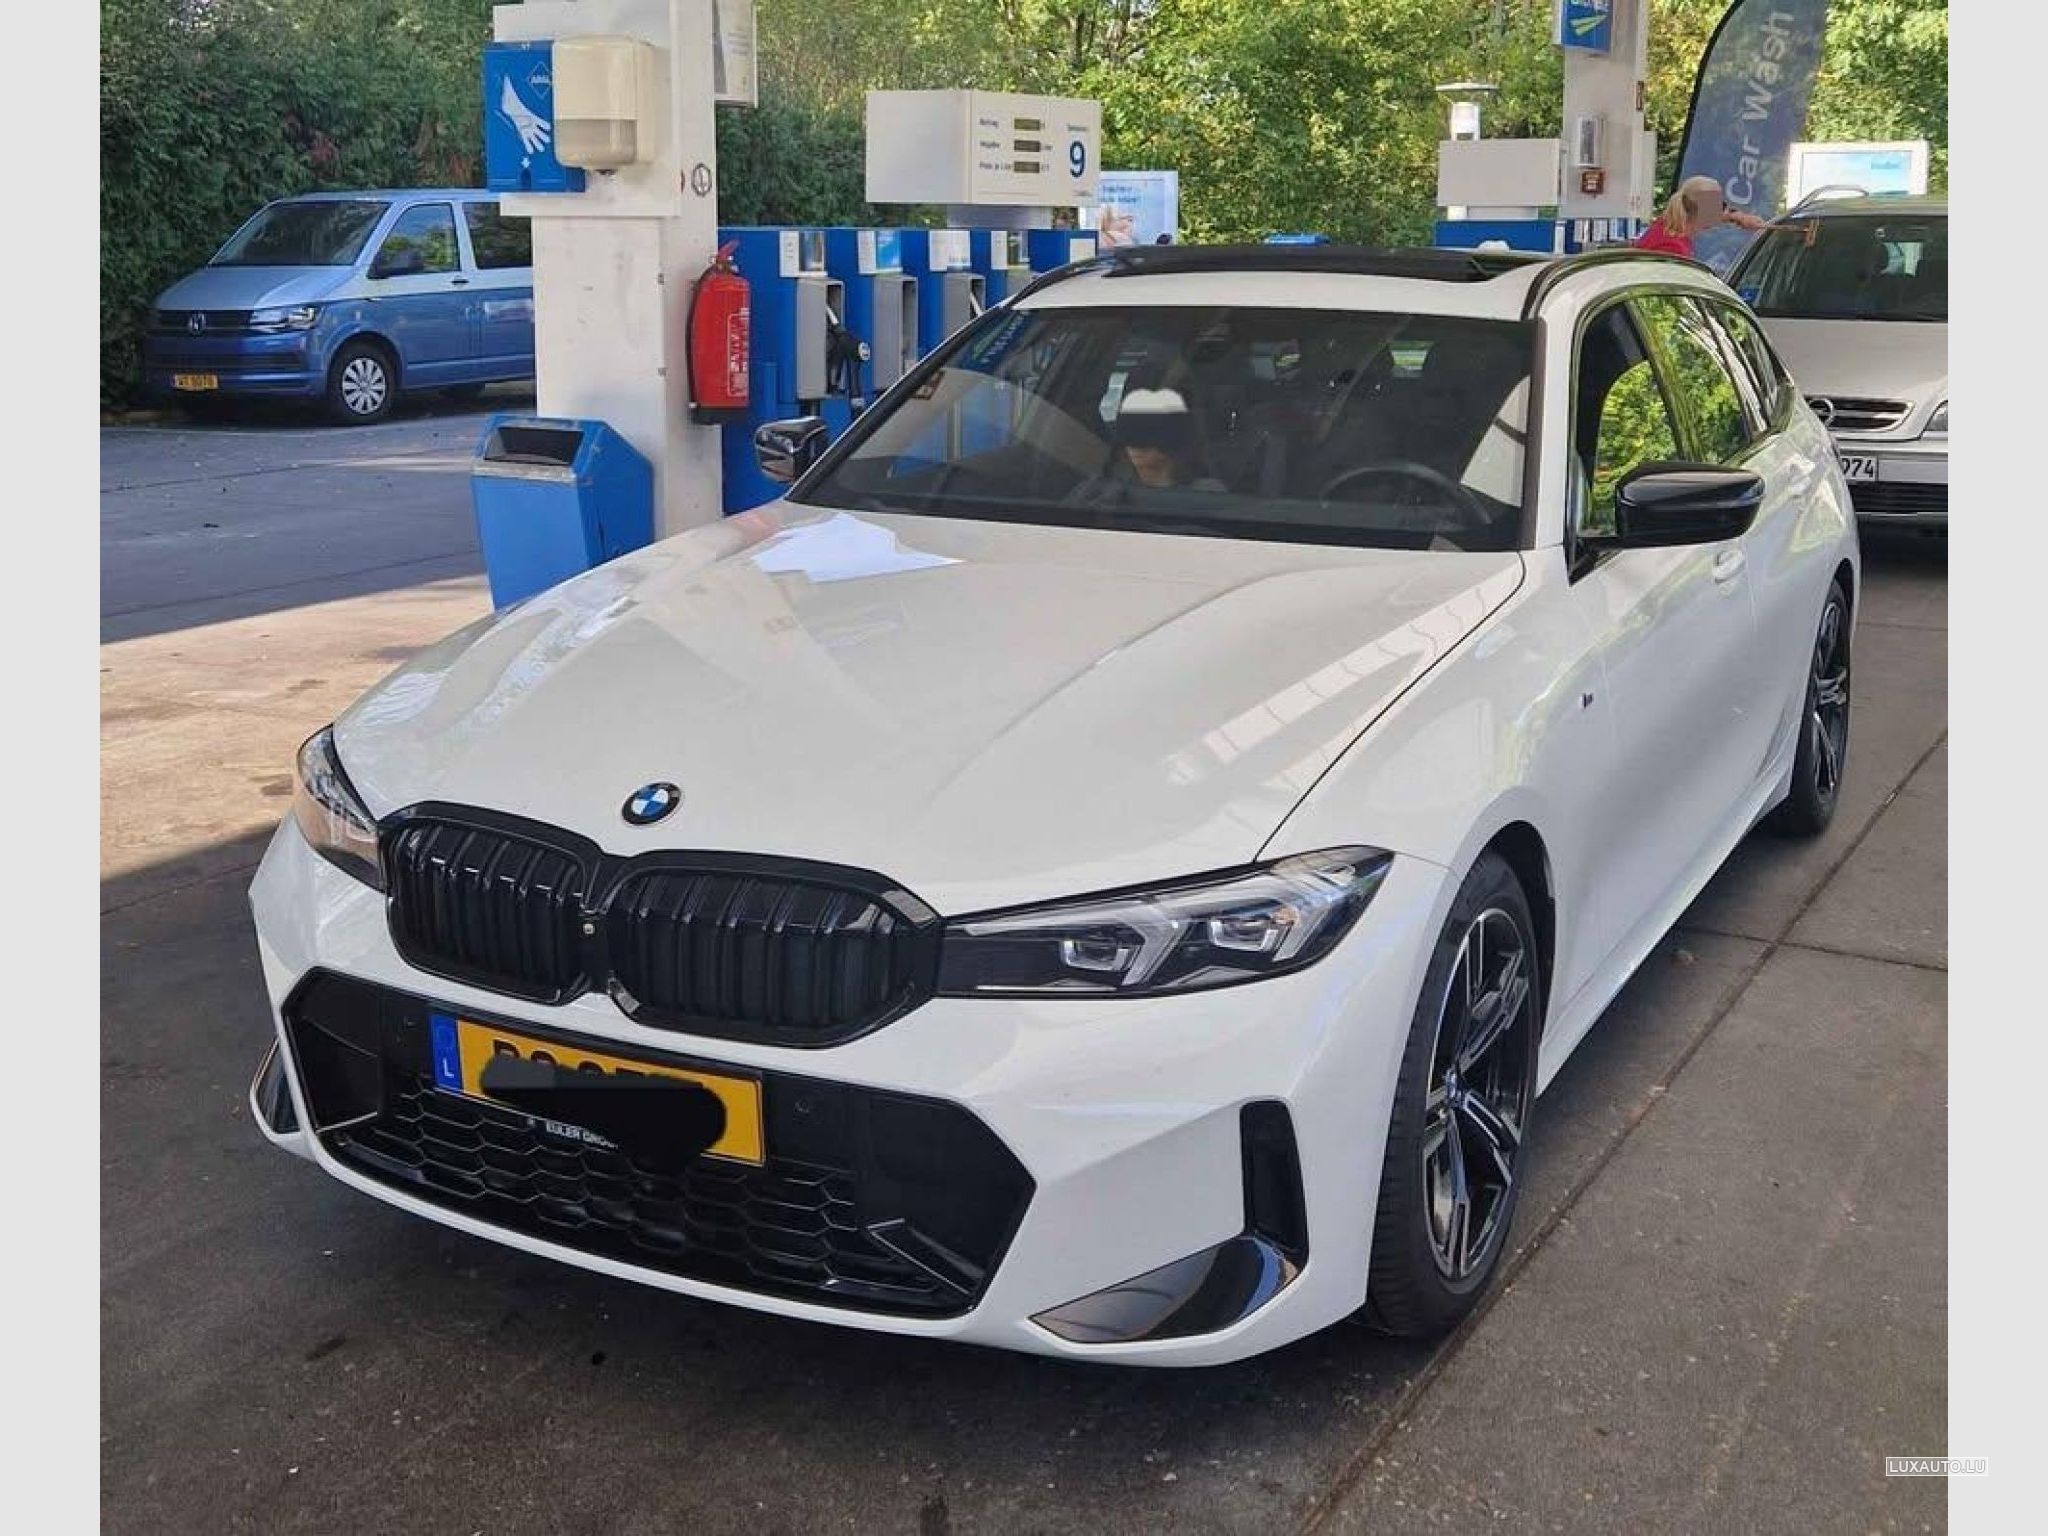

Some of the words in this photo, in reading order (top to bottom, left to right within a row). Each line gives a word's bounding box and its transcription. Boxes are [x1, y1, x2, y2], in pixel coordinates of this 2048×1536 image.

[1742, 12, 1794, 120] Wash
[1068, 139, 1086, 178] 9
[1726, 133, 1760, 204] Car
[442, 1057, 455, 1078] L
